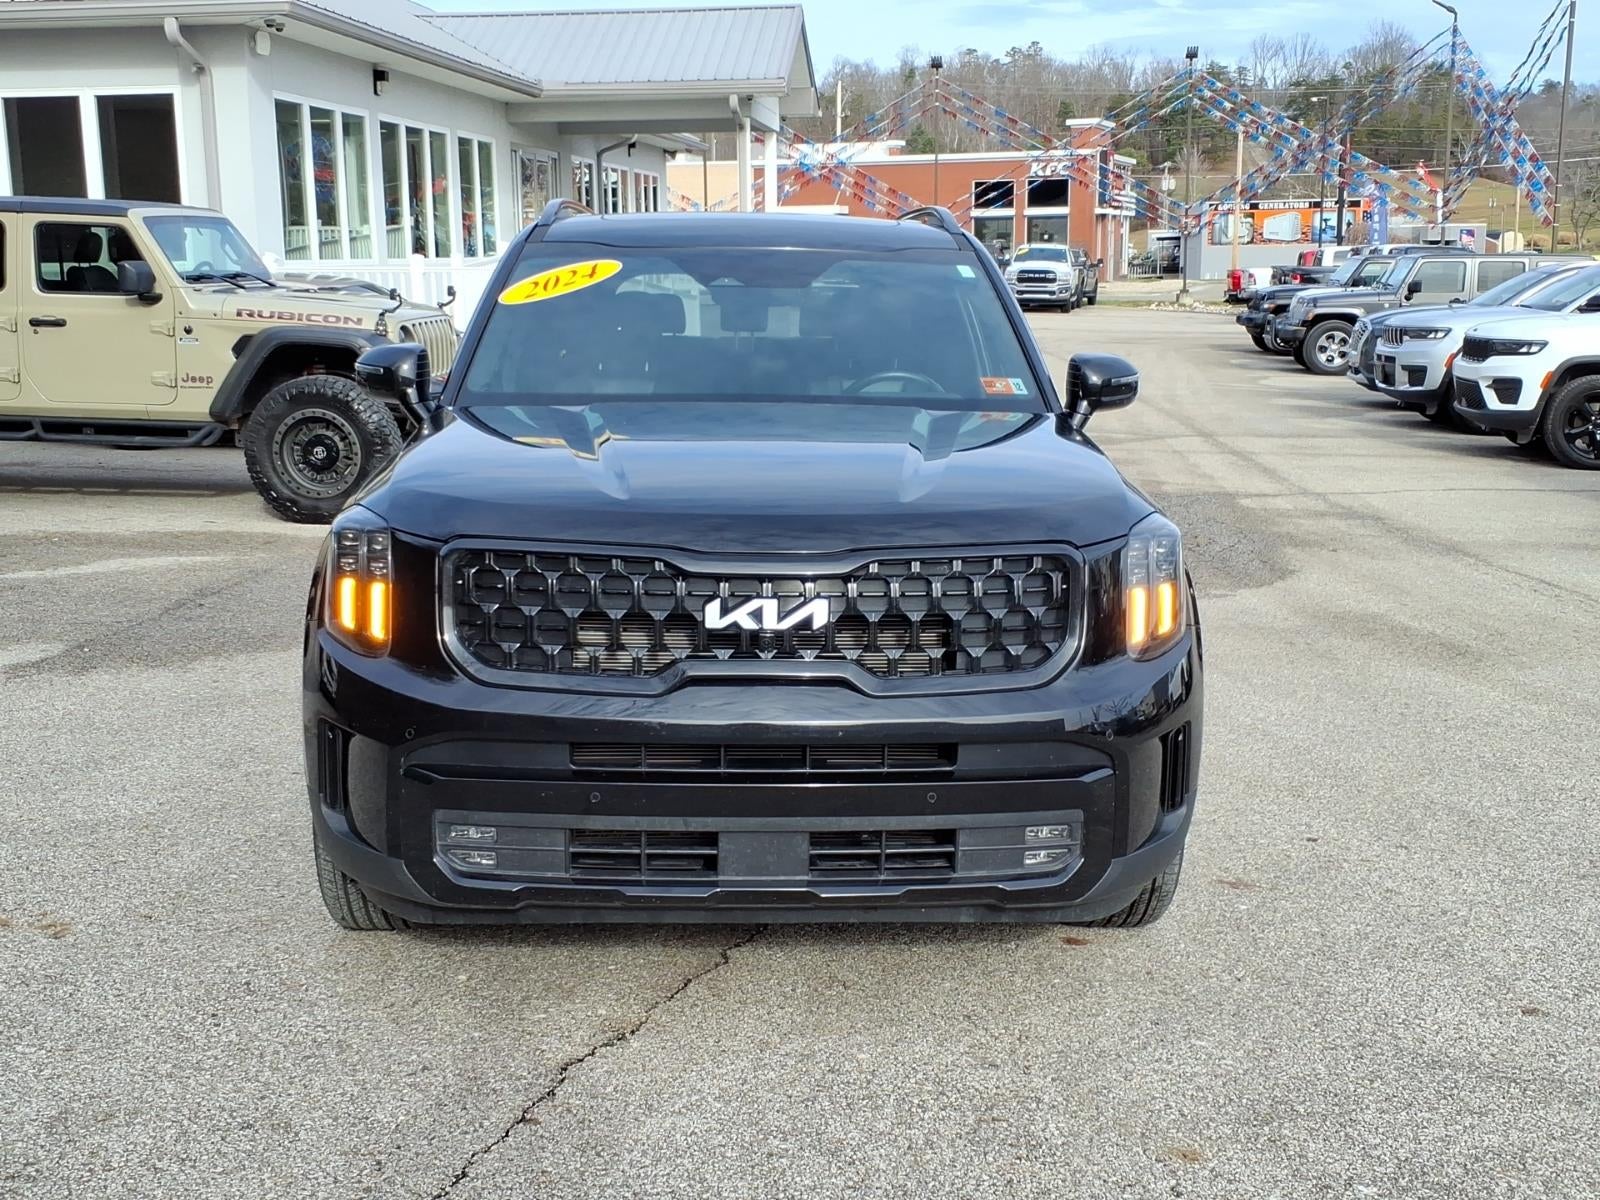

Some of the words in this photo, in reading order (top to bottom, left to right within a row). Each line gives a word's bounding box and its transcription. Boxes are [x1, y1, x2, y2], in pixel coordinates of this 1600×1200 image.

[1030, 161, 1071, 176] KFC
[1258, 202, 1310, 210] GENERATORS
[524, 263, 598, 298] 2024
[236, 308, 363, 326] RUBICON
[181, 372, 213, 385] Jeep
[704, 597, 829, 630] KIA
